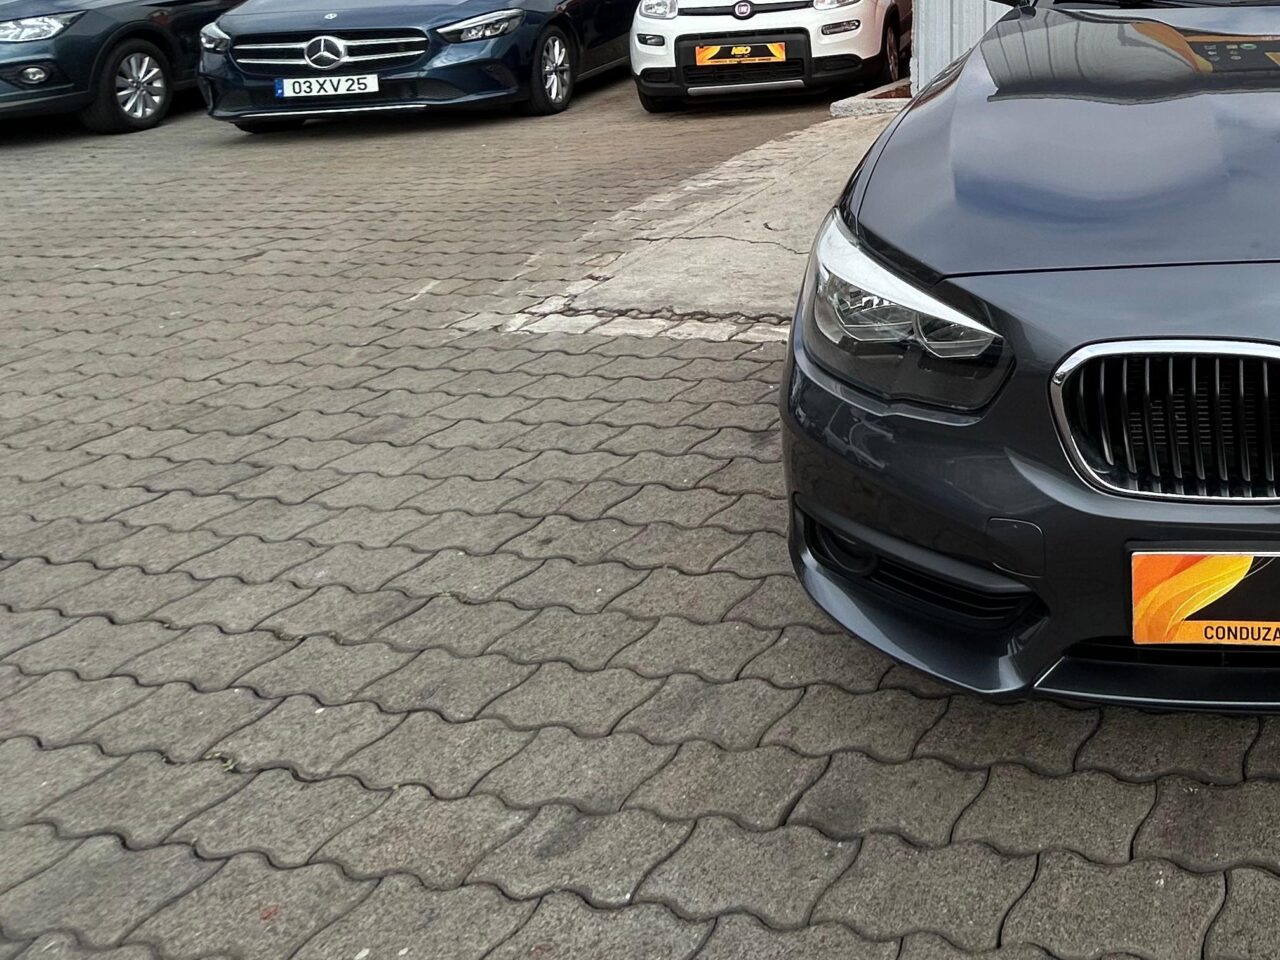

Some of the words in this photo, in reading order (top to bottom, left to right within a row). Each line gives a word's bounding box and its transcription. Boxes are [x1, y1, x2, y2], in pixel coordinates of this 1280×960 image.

[292, 80, 313, 95] 03
[315, 78, 341, 94] XV
[345, 76, 368, 92] 25
